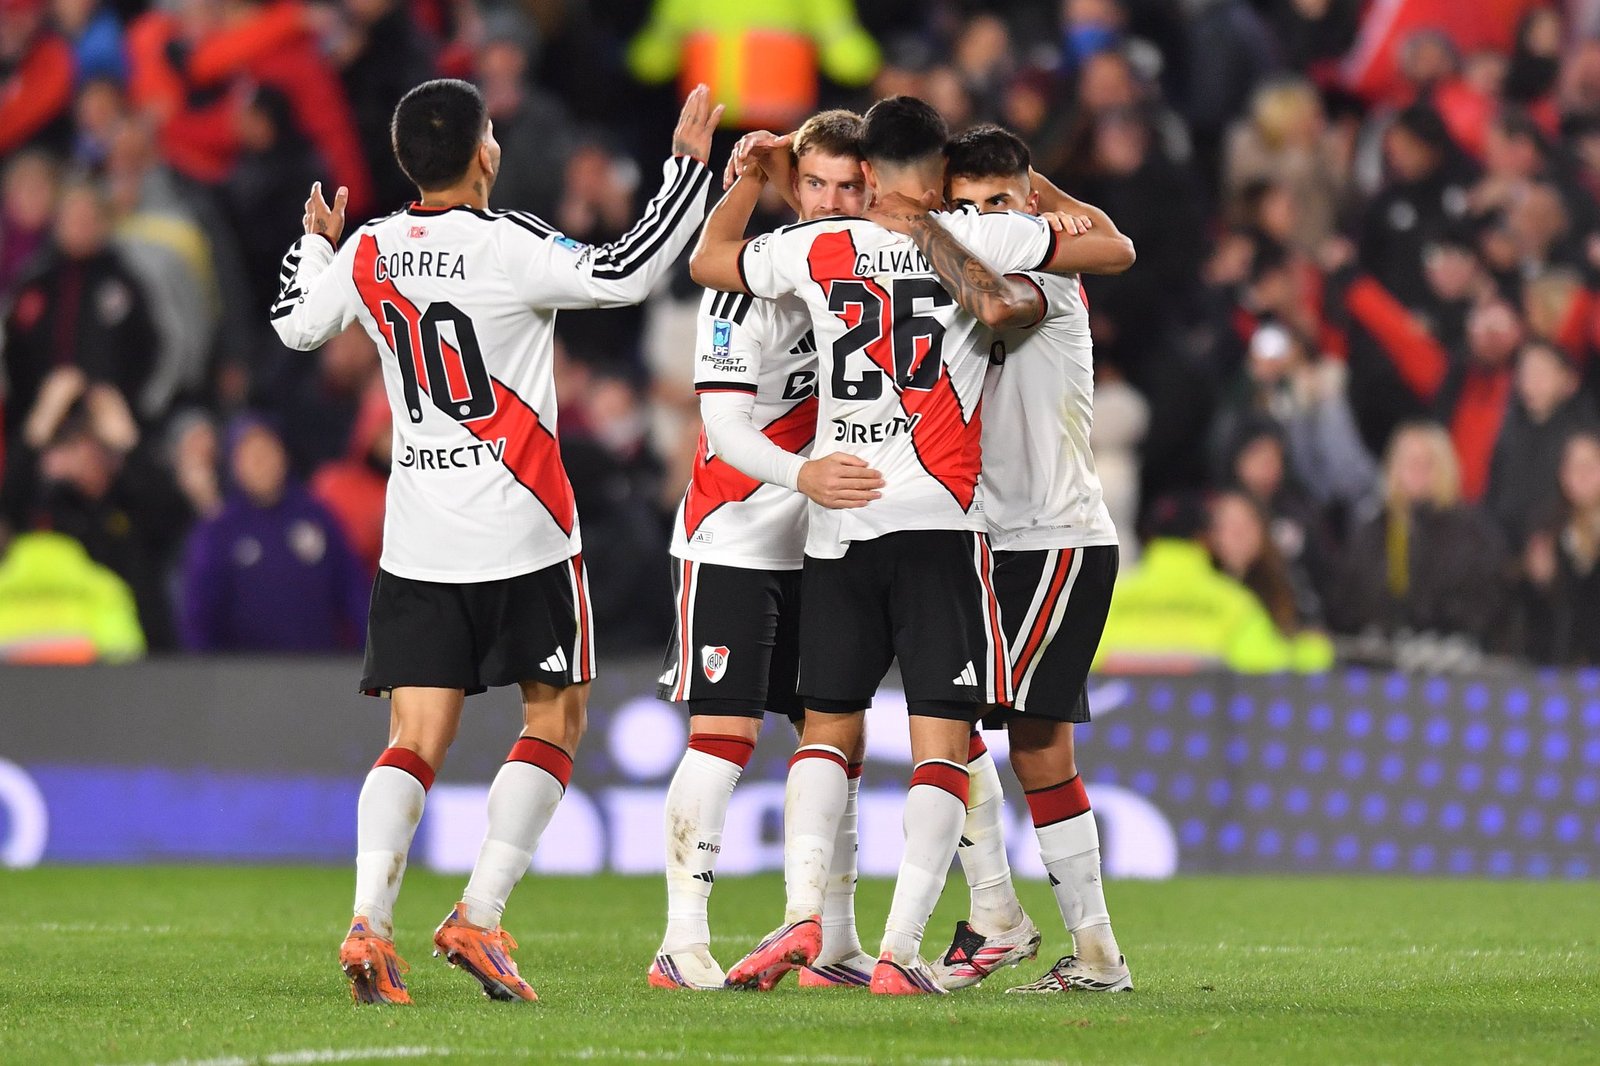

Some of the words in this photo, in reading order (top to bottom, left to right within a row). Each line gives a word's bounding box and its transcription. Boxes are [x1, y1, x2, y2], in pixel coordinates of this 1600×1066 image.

[376, 251, 465, 281] CORREA
[828, 279, 953, 401] 26
[382, 301, 497, 424] 10
[701, 354, 744, 365] ASSIST
[713, 364, 747, 373] CARD
[398, 439, 505, 471] DIRECTV
